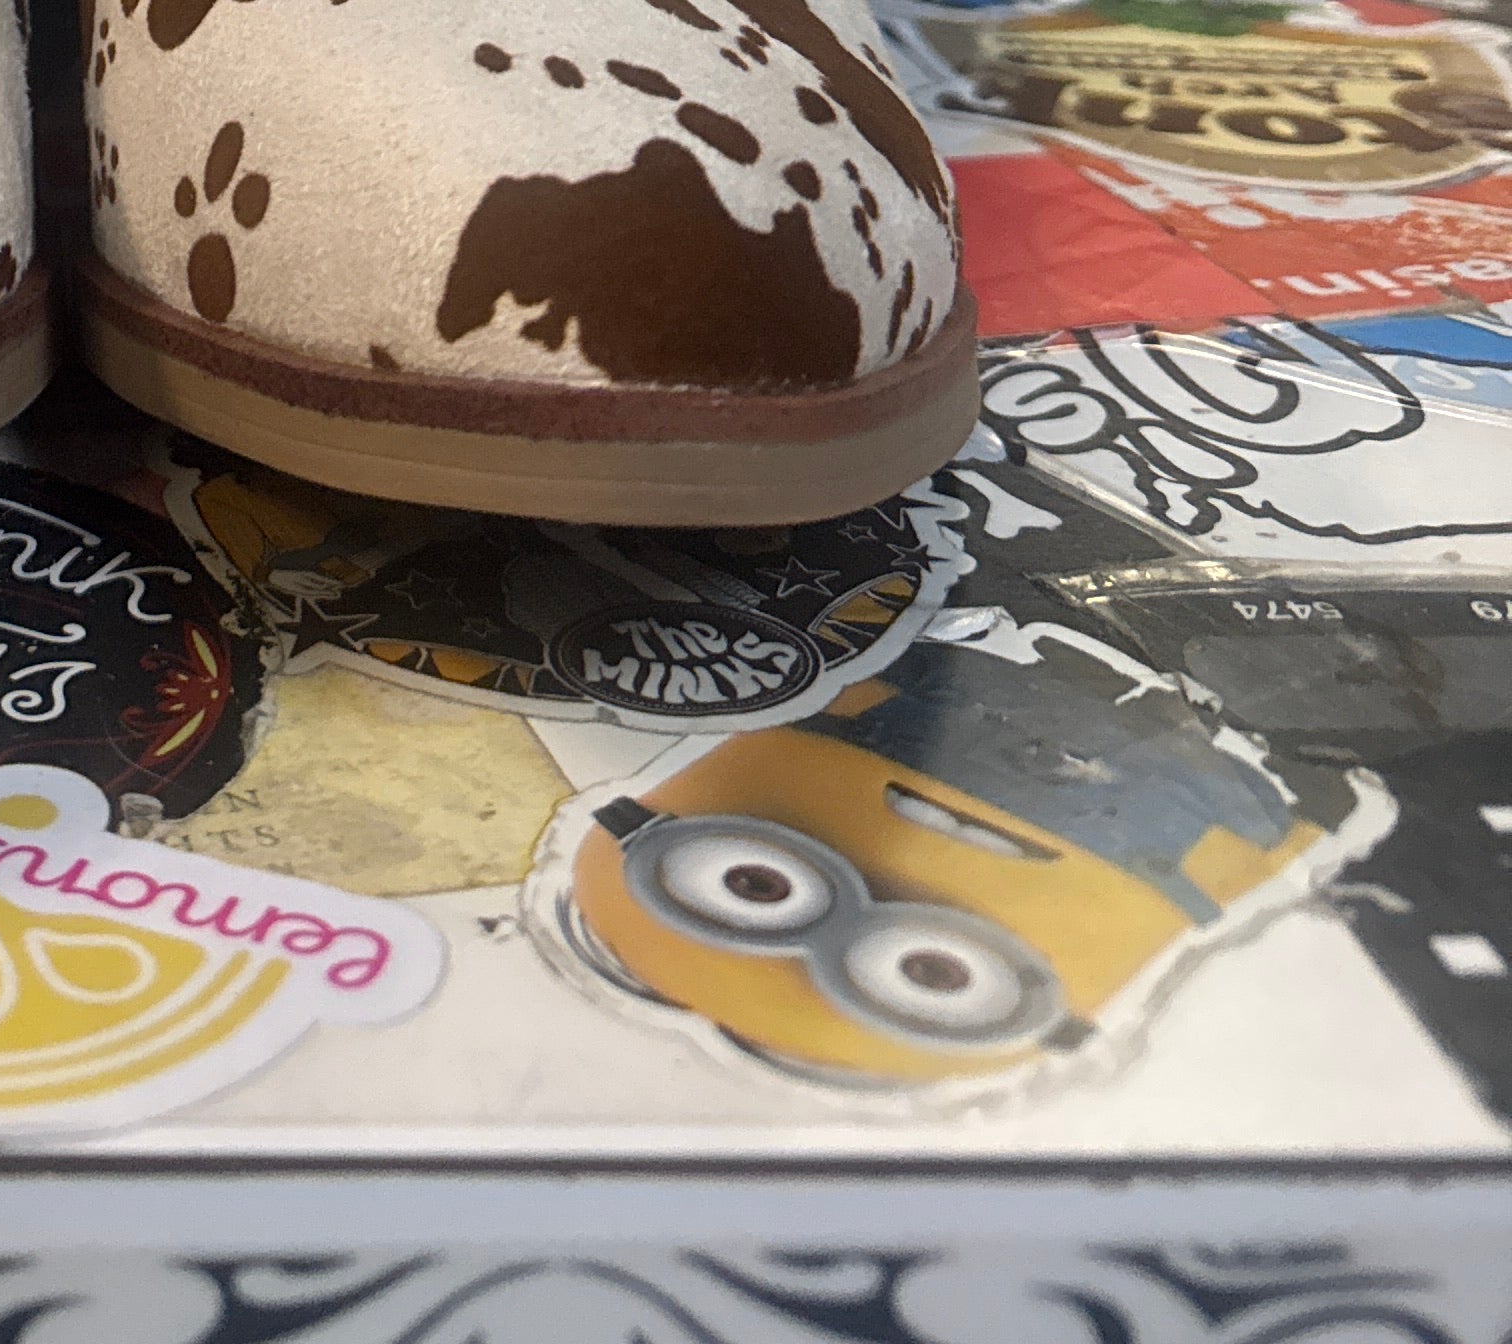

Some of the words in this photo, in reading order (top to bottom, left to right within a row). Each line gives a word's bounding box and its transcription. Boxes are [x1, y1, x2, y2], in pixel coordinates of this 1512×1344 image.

[1231, 599, 1344, 621] 5474
[609, 616, 729, 660] The
[582, 629, 798, 705] MINKS
